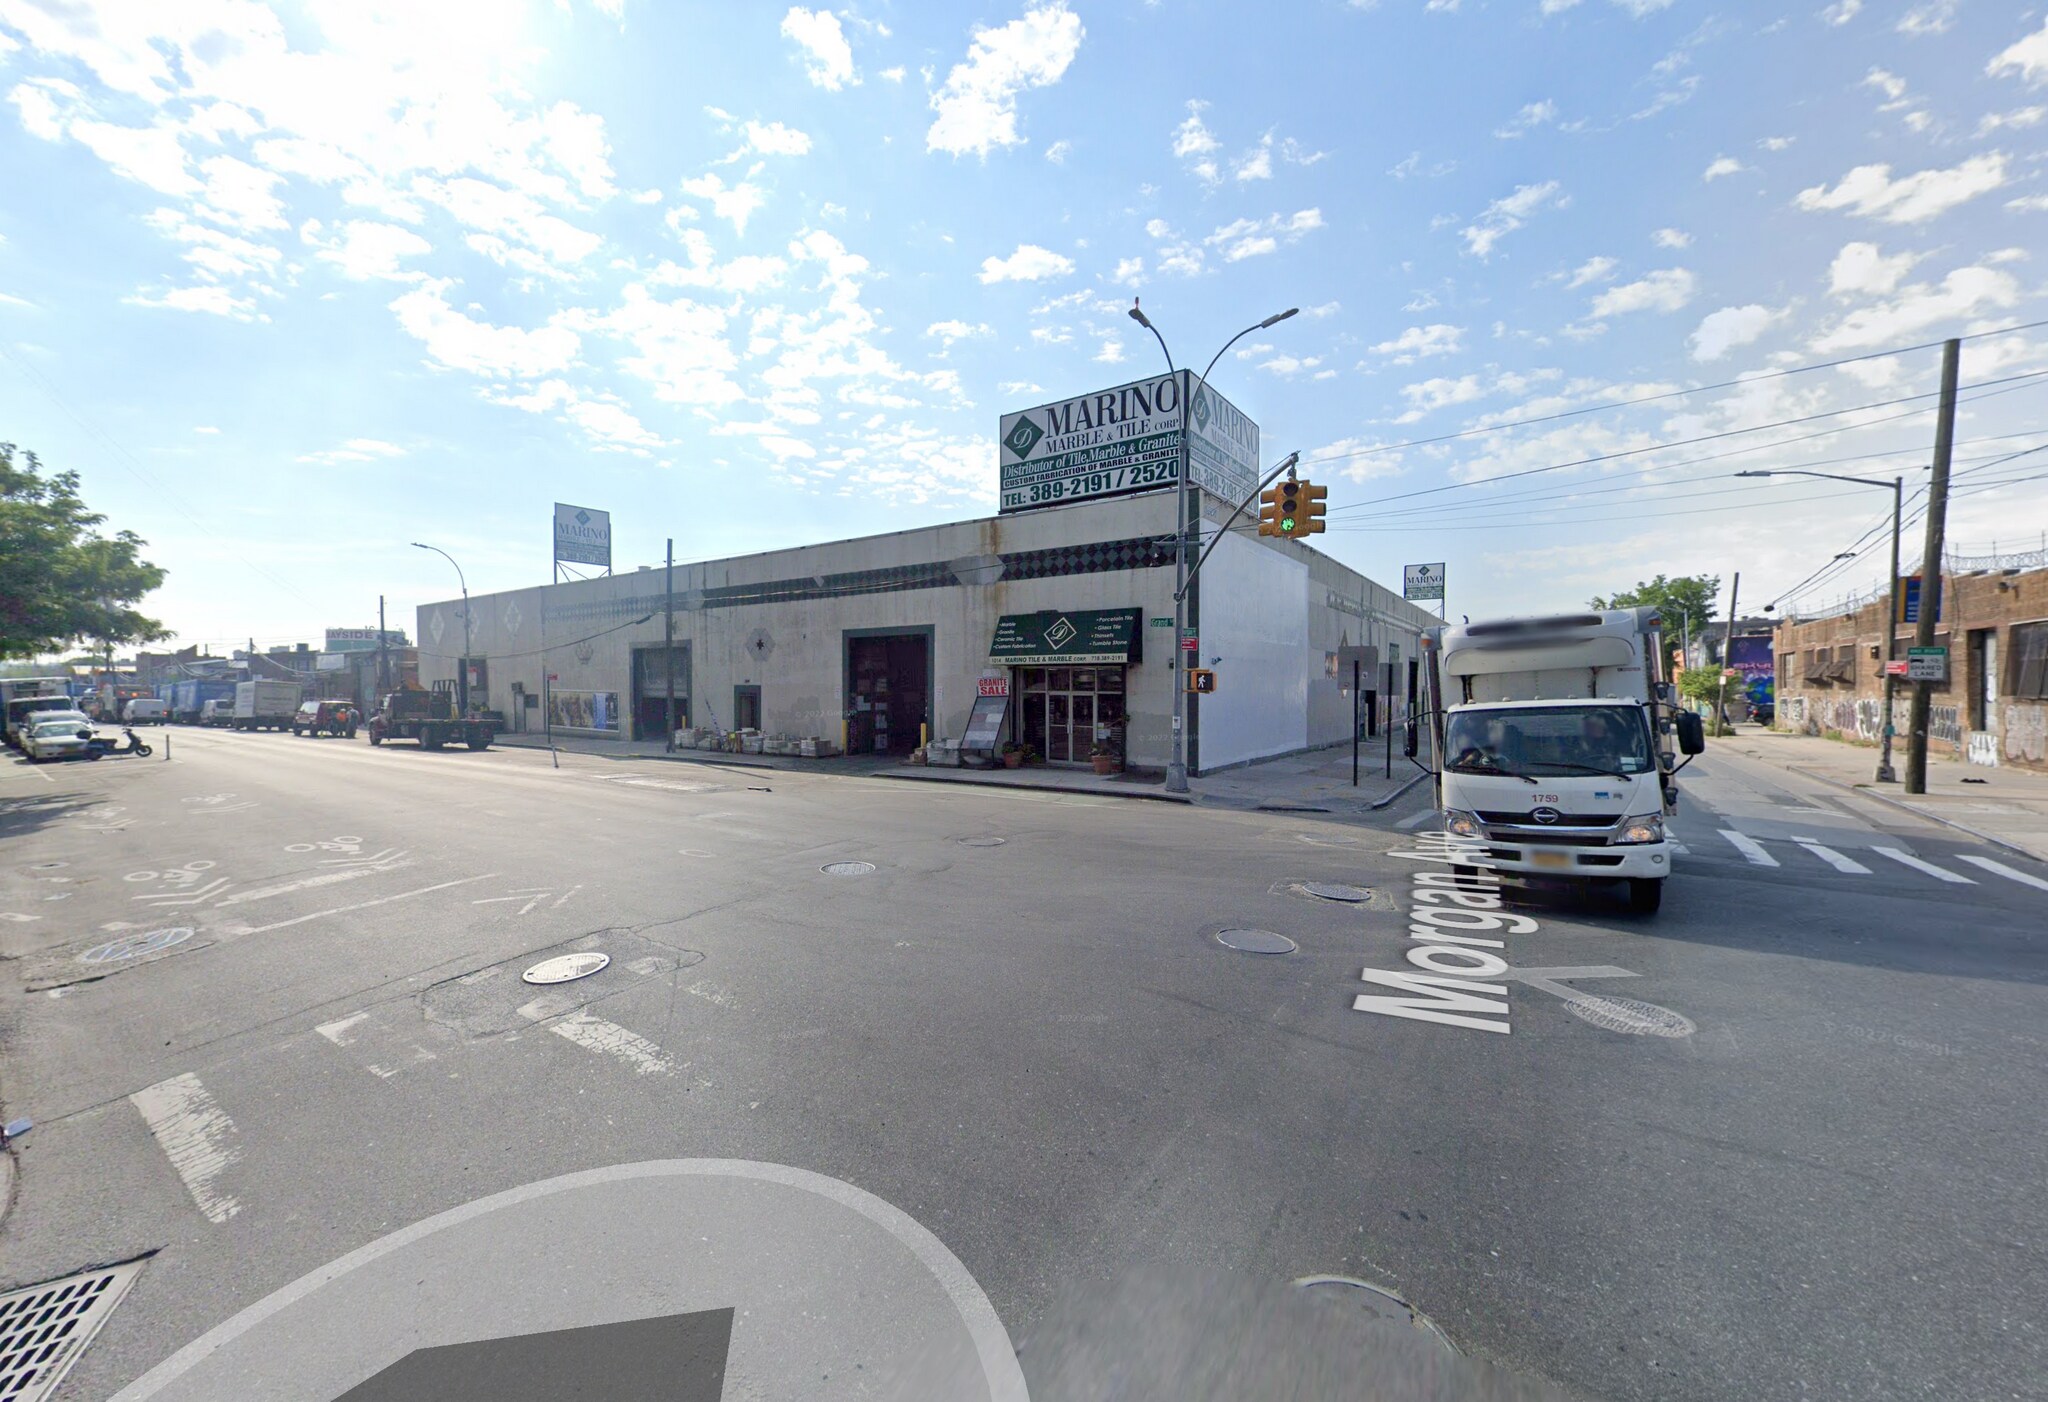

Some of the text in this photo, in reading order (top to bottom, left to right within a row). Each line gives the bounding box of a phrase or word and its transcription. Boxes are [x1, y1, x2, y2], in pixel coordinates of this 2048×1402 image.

[1045, 379, 1178, 439] MARINO
[1211, 392, 1258, 455] MARINO
[1045, 429, 1103, 454] MARBLE
[1106, 432, 1113, 441] &
[1116, 419, 1151, 439] TILE
[1004, 460, 1054, 478] Distributor
[1055, 456, 1067, 468] of
[1087, 444, 1125, 462] Marble
[1128, 443, 1136, 453] &
[1138, 435, 1180, 452] Granite
[1004, 475, 1035, 487] CUSTOM
[1036, 466, 1086, 482] FABRICATION
[1088, 463, 1098, 471] OF
[1099, 457, 1132, 469] MARBLE
[1142, 448, 1180, 461] GRANITE
[1004, 492, 1027, 506] TEL:
[1029, 472, 1112, 502] 389-2191
[1116, 469, 1125, 488] /
[1129, 459, 1179, 485] 2520
[559, 523, 607, 540] MARINO
[1407, 575, 1442, 584] MARINO
[979, 678, 1008, 687] GRANITE
[981, 687, 1007, 695] SALE
[1532, 794, 1559, 803] 1759
